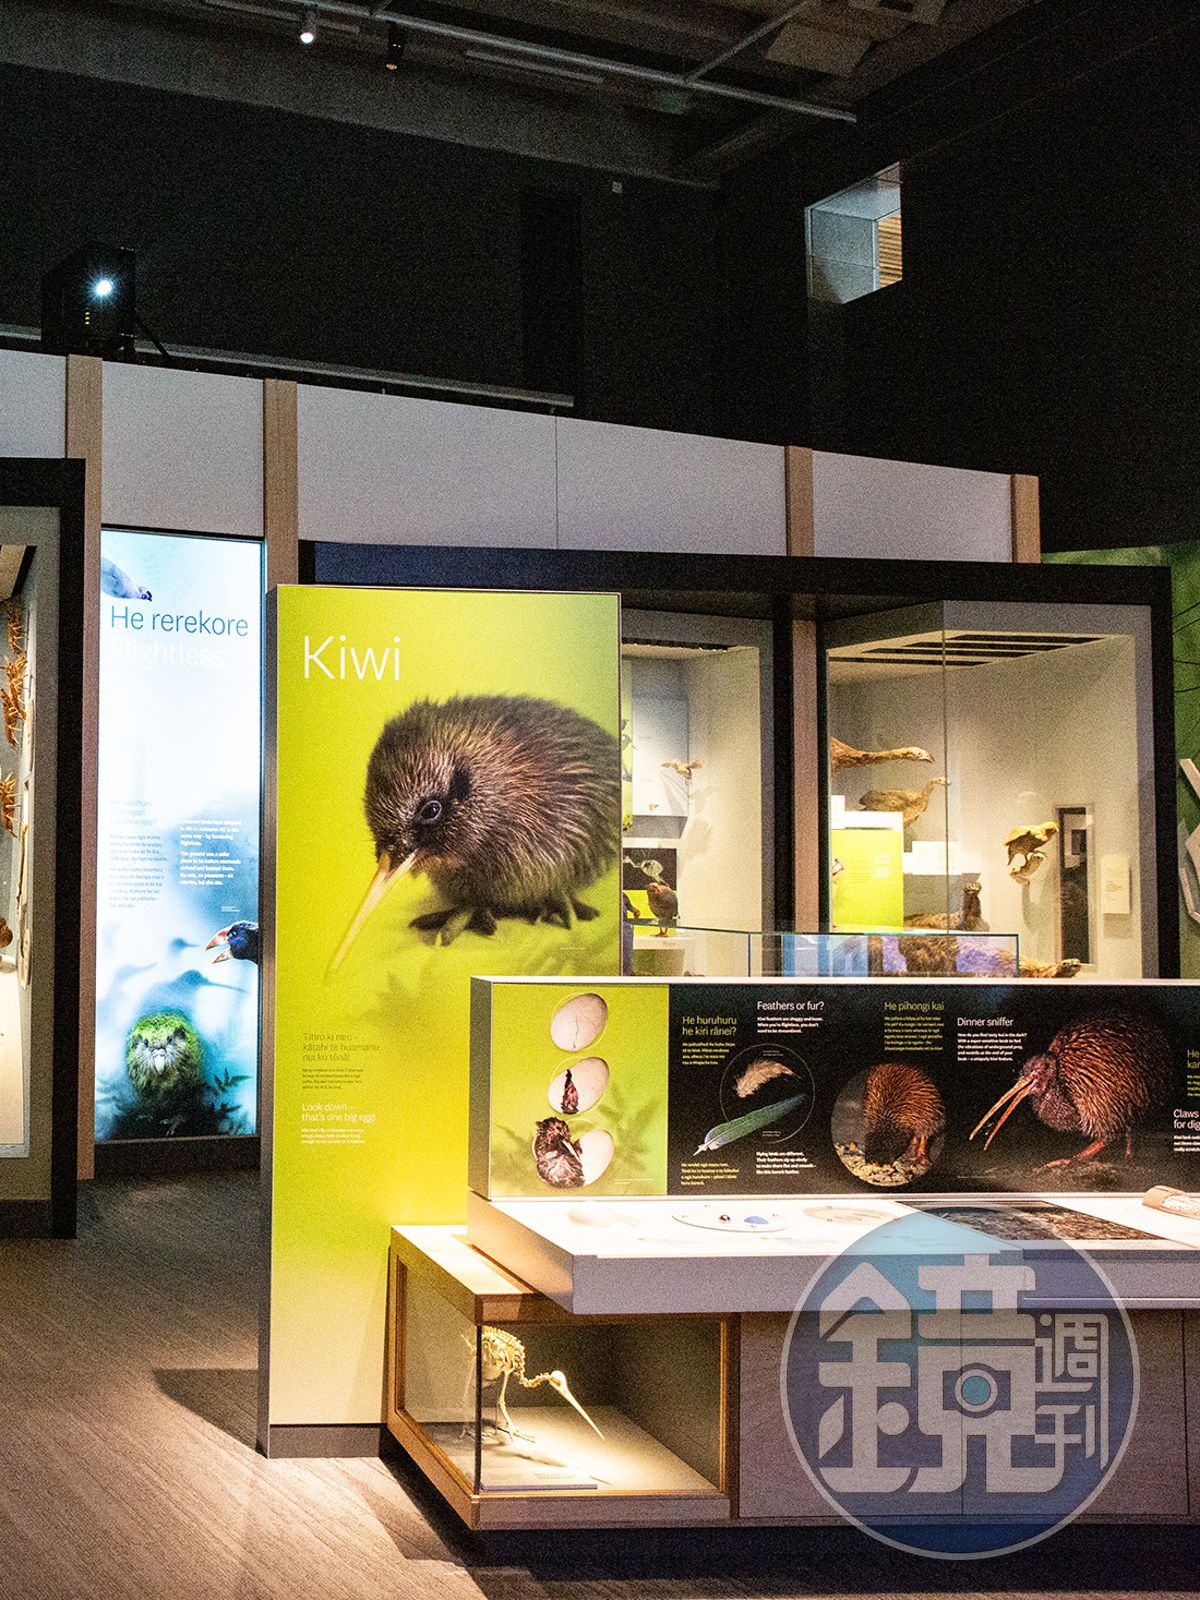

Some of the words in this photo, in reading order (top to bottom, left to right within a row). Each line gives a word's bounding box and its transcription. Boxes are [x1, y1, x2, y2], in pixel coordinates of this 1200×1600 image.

[111, 606, 144, 630] He
[152, 610, 248, 636] rerekore
[304, 635, 400, 680] Kiwi
[757, 1001, 795, 1010] Feathers
[807, 1001, 825, 1010] fur?
[885, 1002, 897, 1010] He
[932, 1001, 944, 1010] kai
[682, 1016, 695, 1024] He
[697, 1015, 737, 1024] huruhuru
[958, 1017, 985, 1026] Dinner
[987, 1017, 1014, 1026] sniffer
[682, 1026, 694, 1035] he
[1174, 1109, 1199, 1118] Claws
[344, 1113, 357, 1124] big
[1174, 1119, 1186, 1129] for
